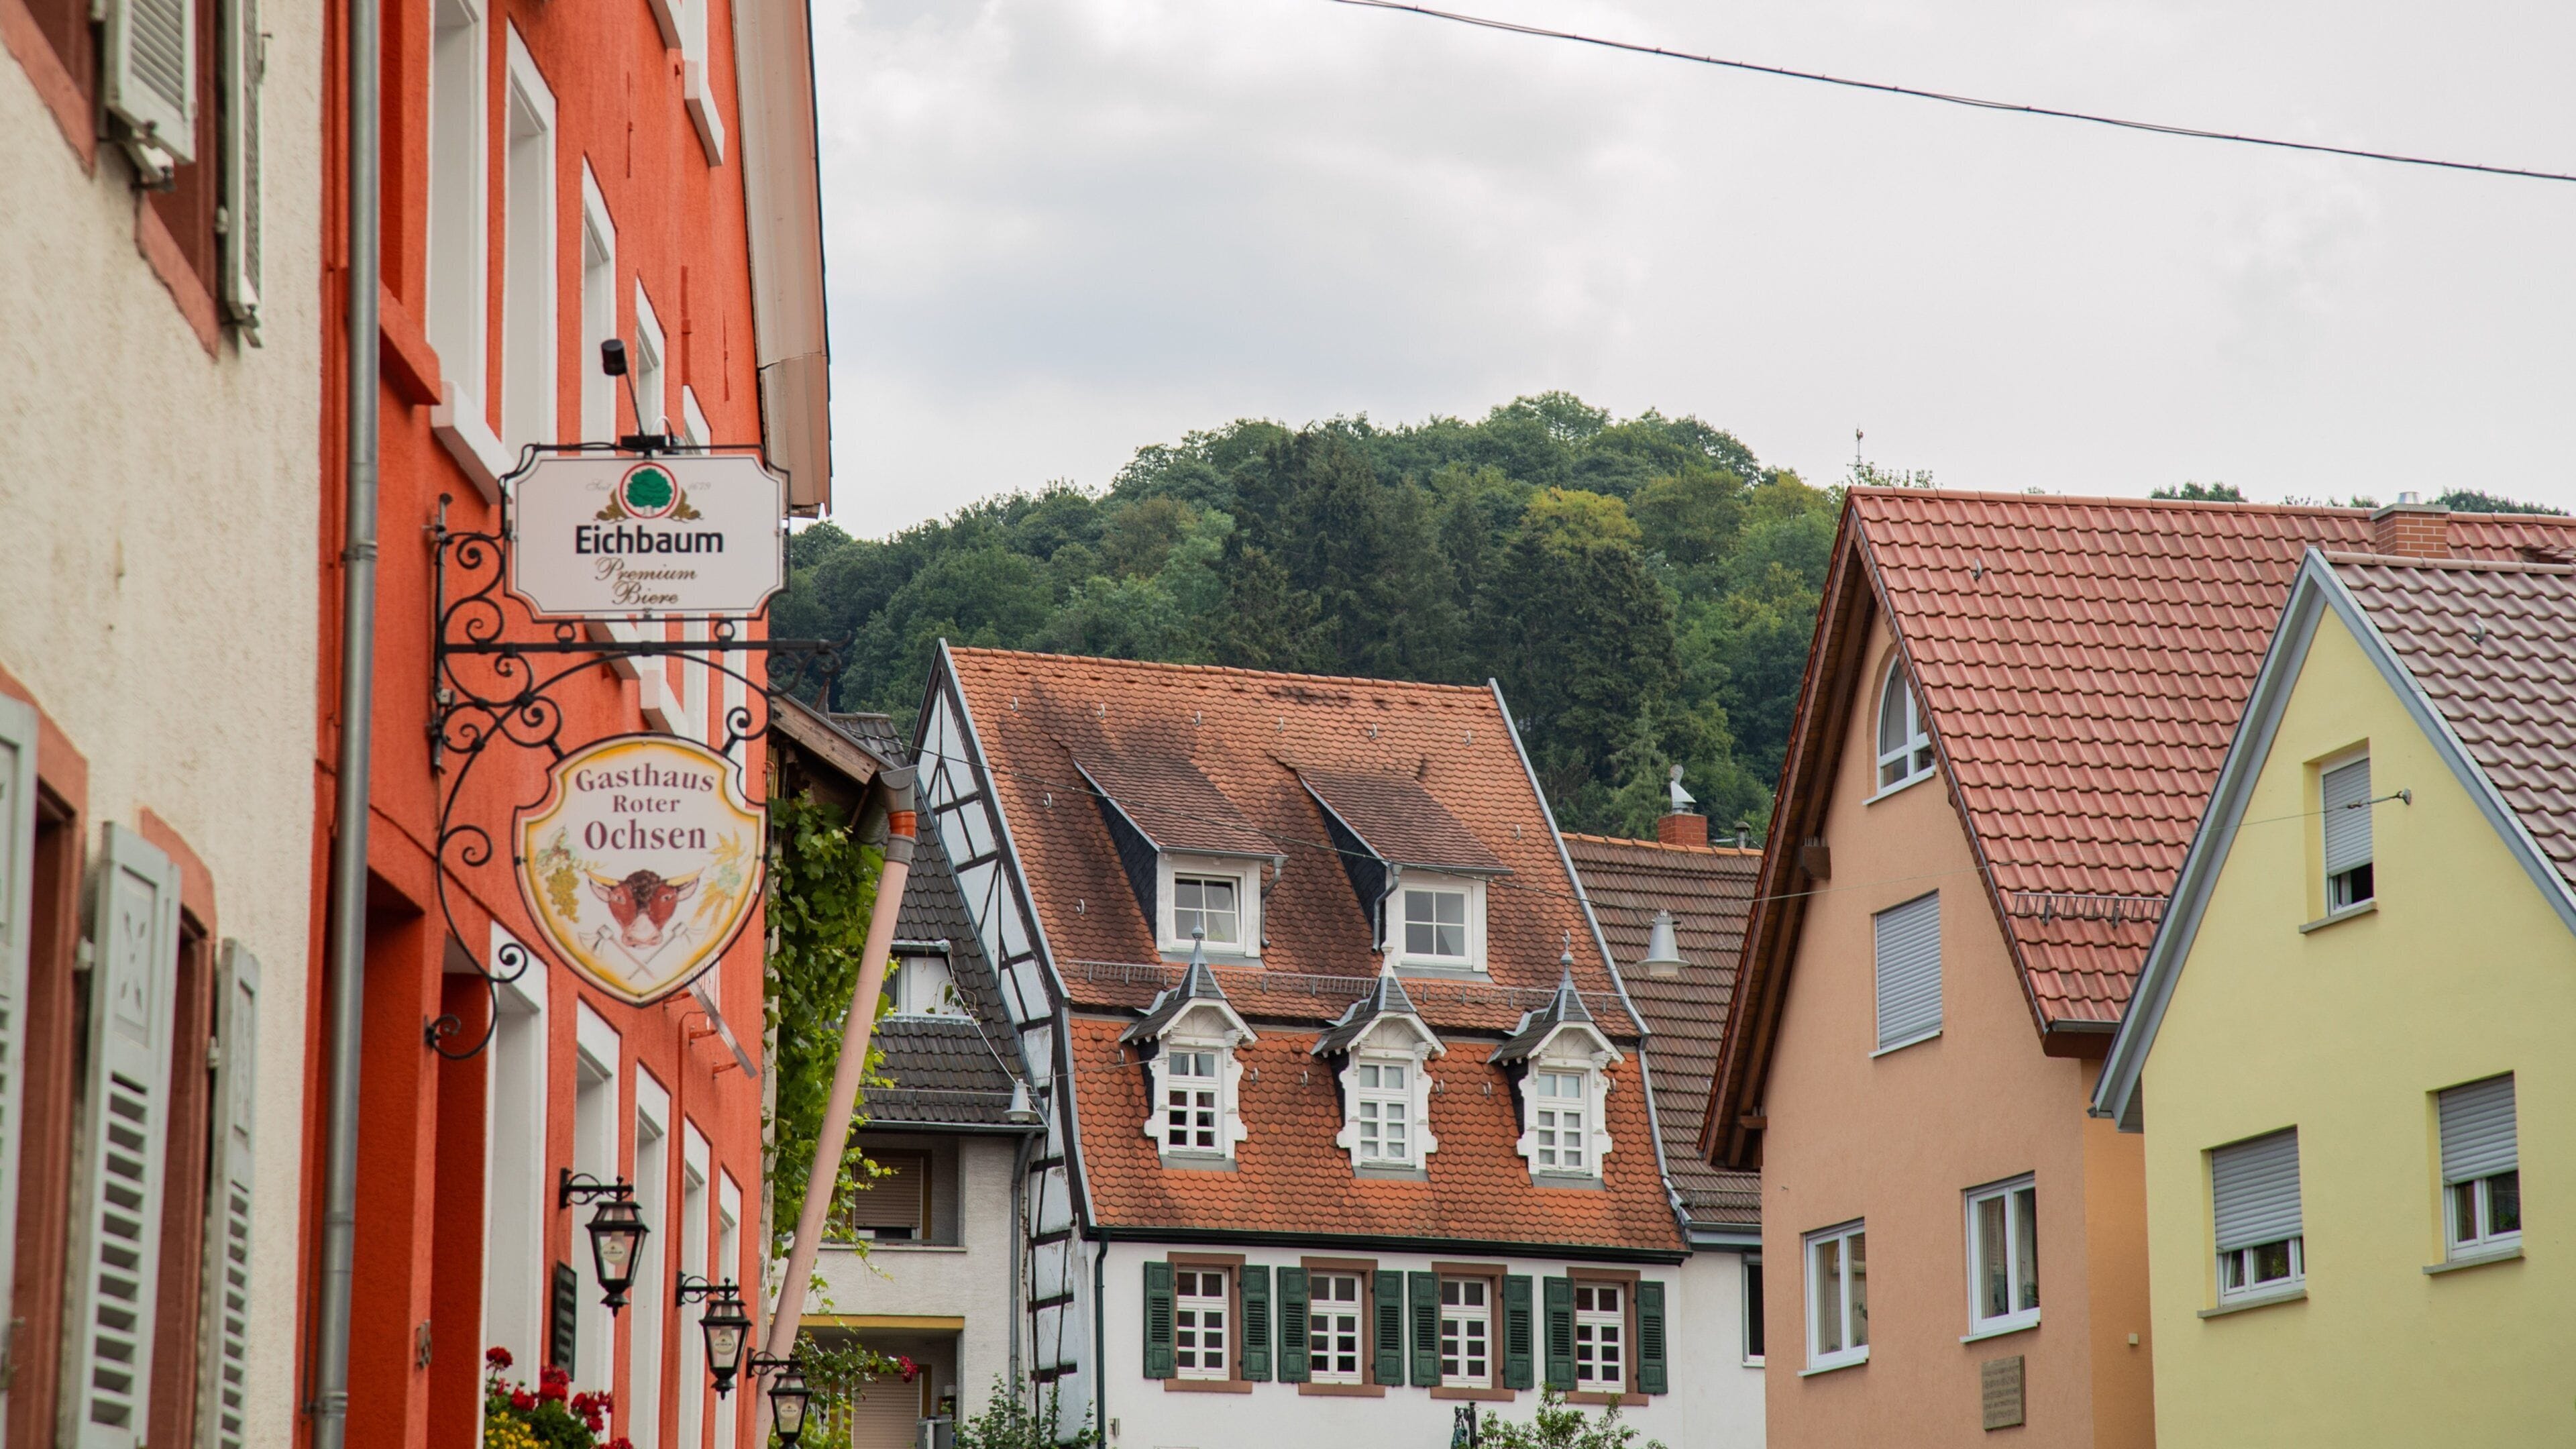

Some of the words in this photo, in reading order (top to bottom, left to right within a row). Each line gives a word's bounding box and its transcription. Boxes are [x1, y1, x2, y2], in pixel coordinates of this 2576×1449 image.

[576, 525, 724, 554] Eichbaum
[594, 557, 697, 580] Premium
[612, 580, 679, 604] Biere
[576, 762, 715, 792] Gasthaus
[613, 794, 681, 813] Roter
[584, 818, 707, 850] Ochsen
